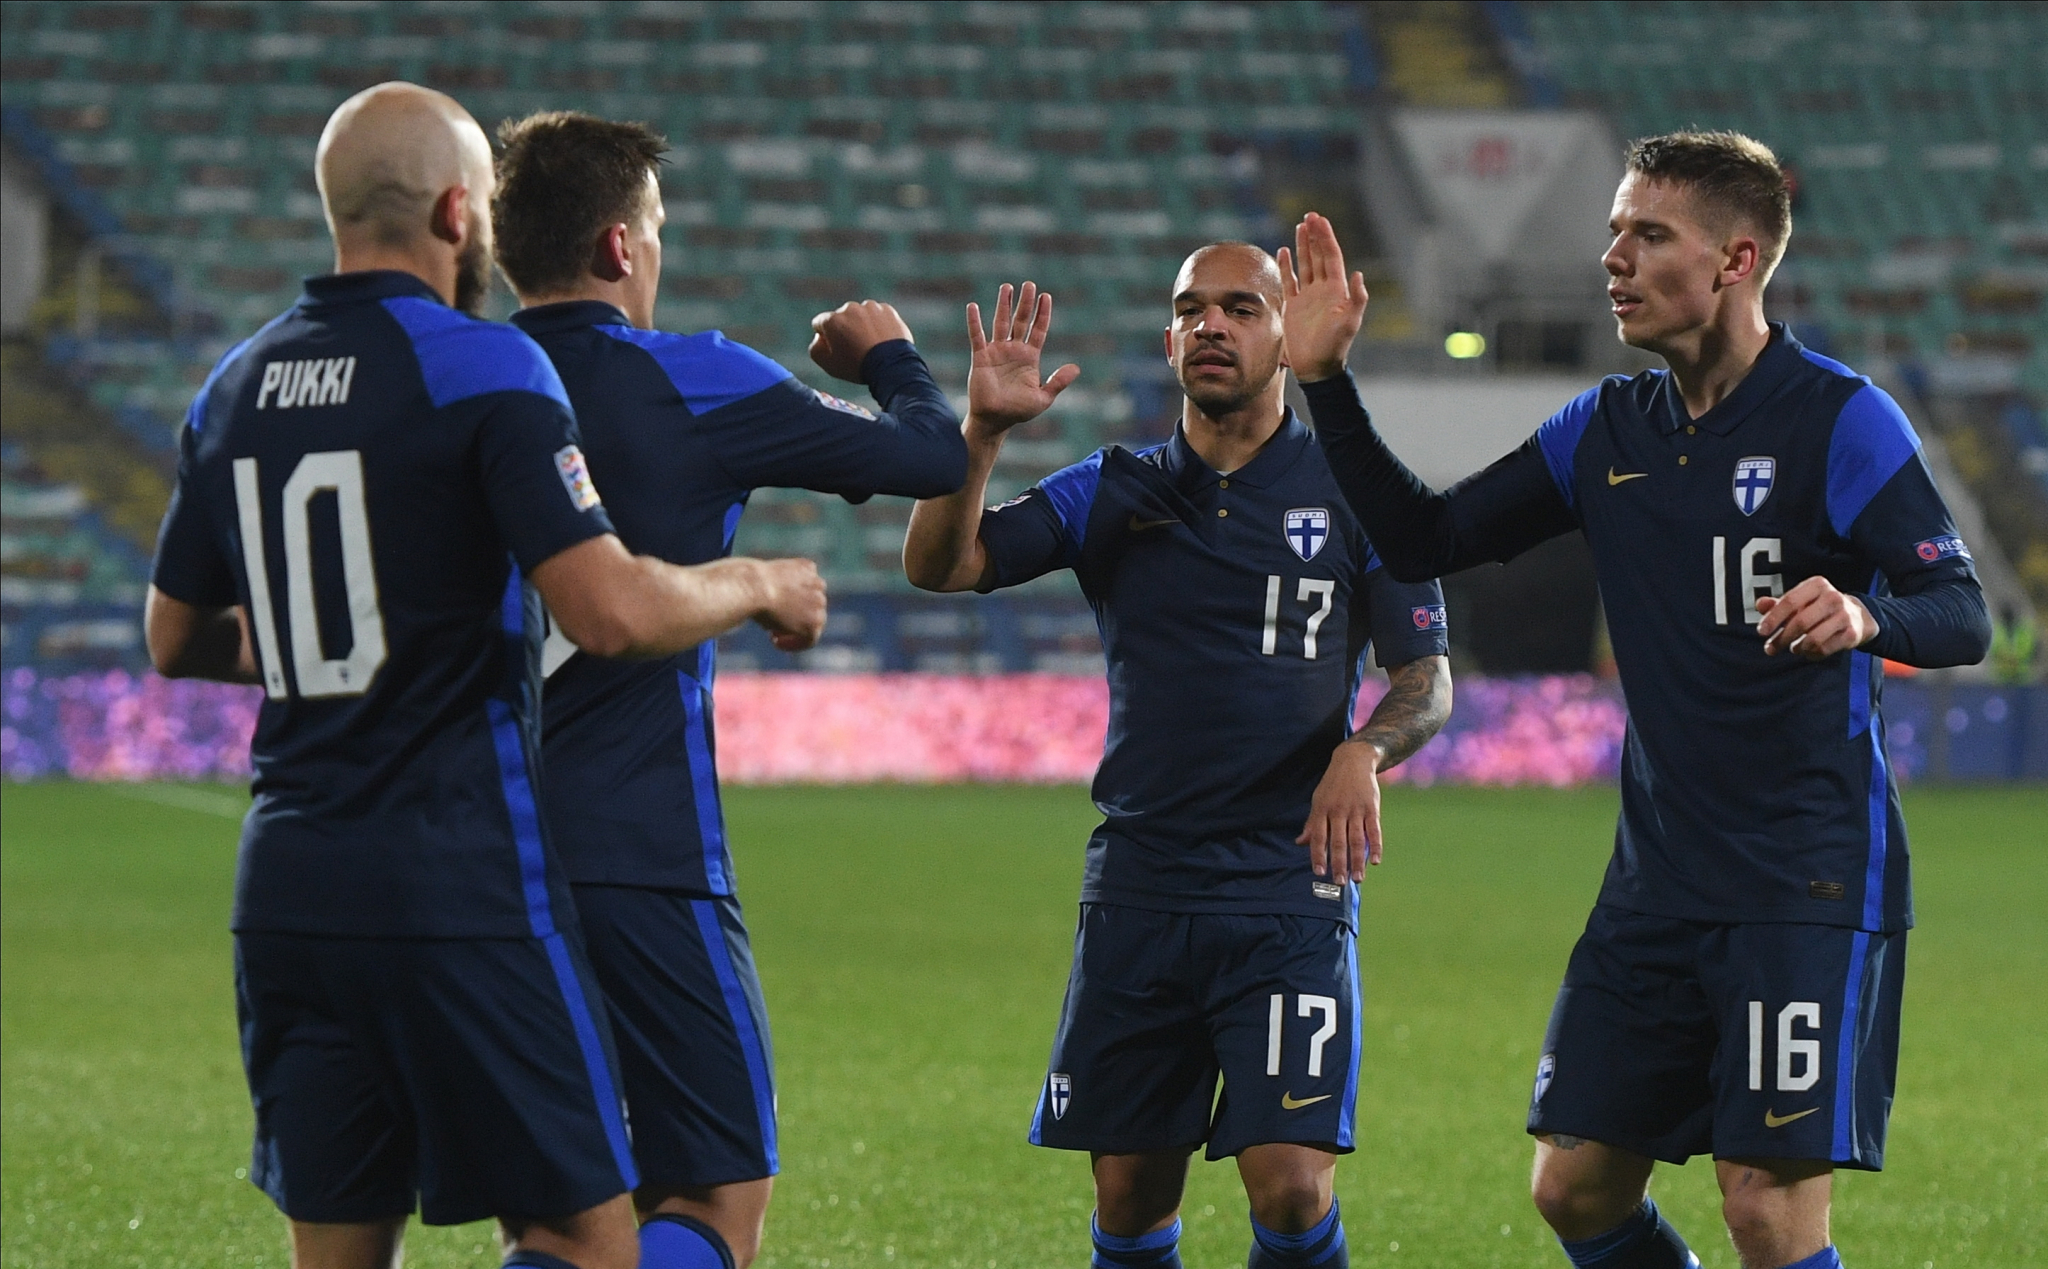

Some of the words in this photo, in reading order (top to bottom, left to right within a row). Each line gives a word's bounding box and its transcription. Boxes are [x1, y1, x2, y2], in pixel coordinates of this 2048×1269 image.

[256, 356, 357, 410] PUKKI
[232, 449, 389, 700] 10
[1262, 574, 1335, 660] 17
[1712, 536, 1784, 625] 16
[1266, 993, 1337, 1077] 17
[1748, 1000, 1821, 1091] 16
